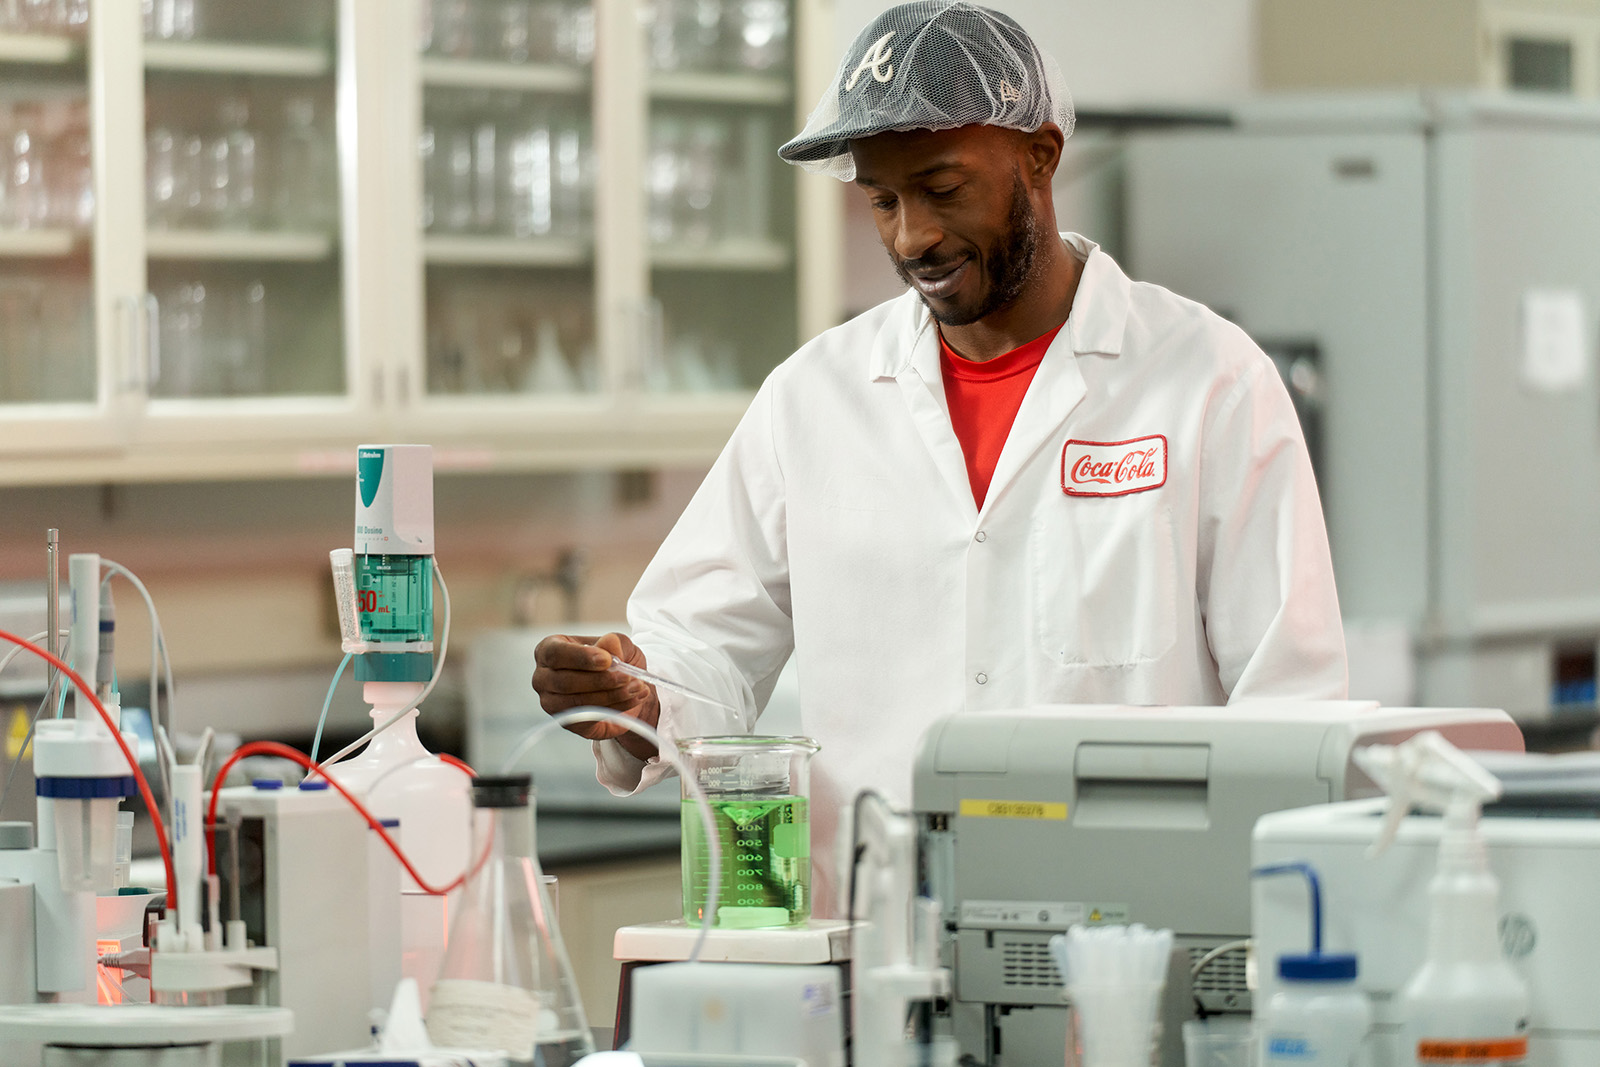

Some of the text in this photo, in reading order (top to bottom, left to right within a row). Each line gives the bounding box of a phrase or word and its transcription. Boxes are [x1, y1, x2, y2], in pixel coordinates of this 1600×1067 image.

[846, 31, 896, 91] A
[358, 590, 377, 613] 50
[378, 605, 391, 613] mL
